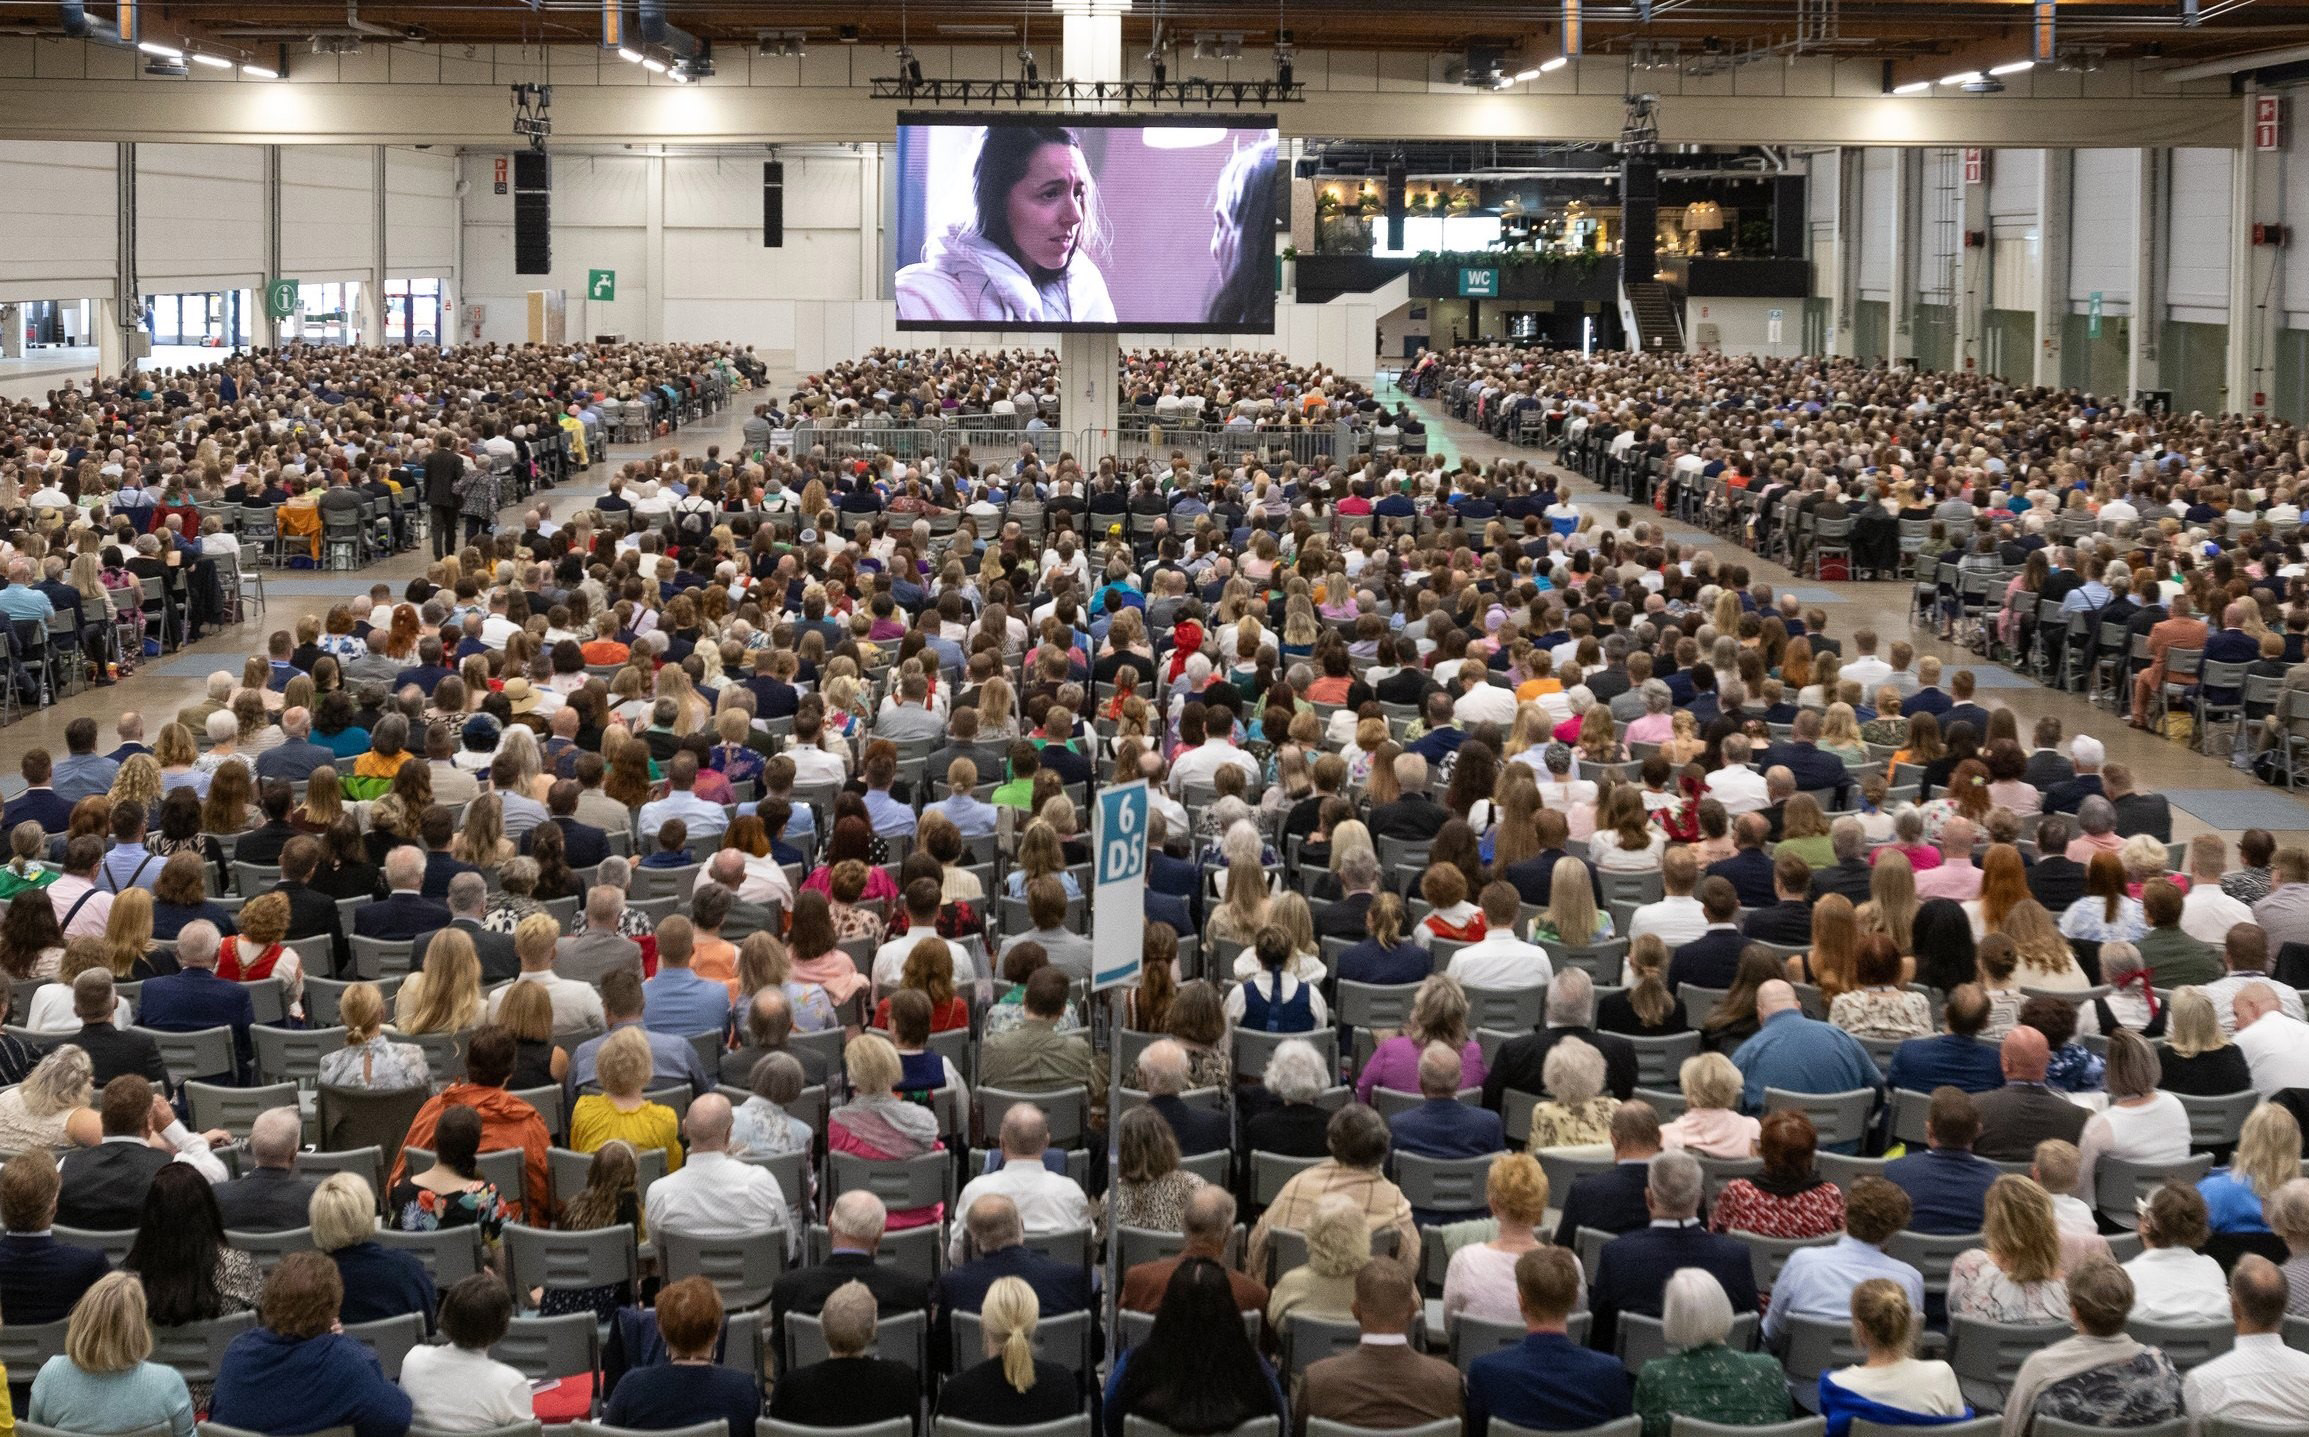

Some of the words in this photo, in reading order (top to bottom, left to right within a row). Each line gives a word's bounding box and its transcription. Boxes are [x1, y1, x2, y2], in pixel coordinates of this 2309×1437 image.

[1467, 270, 1490, 285] WC
[1118, 792, 1135, 833] 6
[1107, 832, 1142, 880] D5
